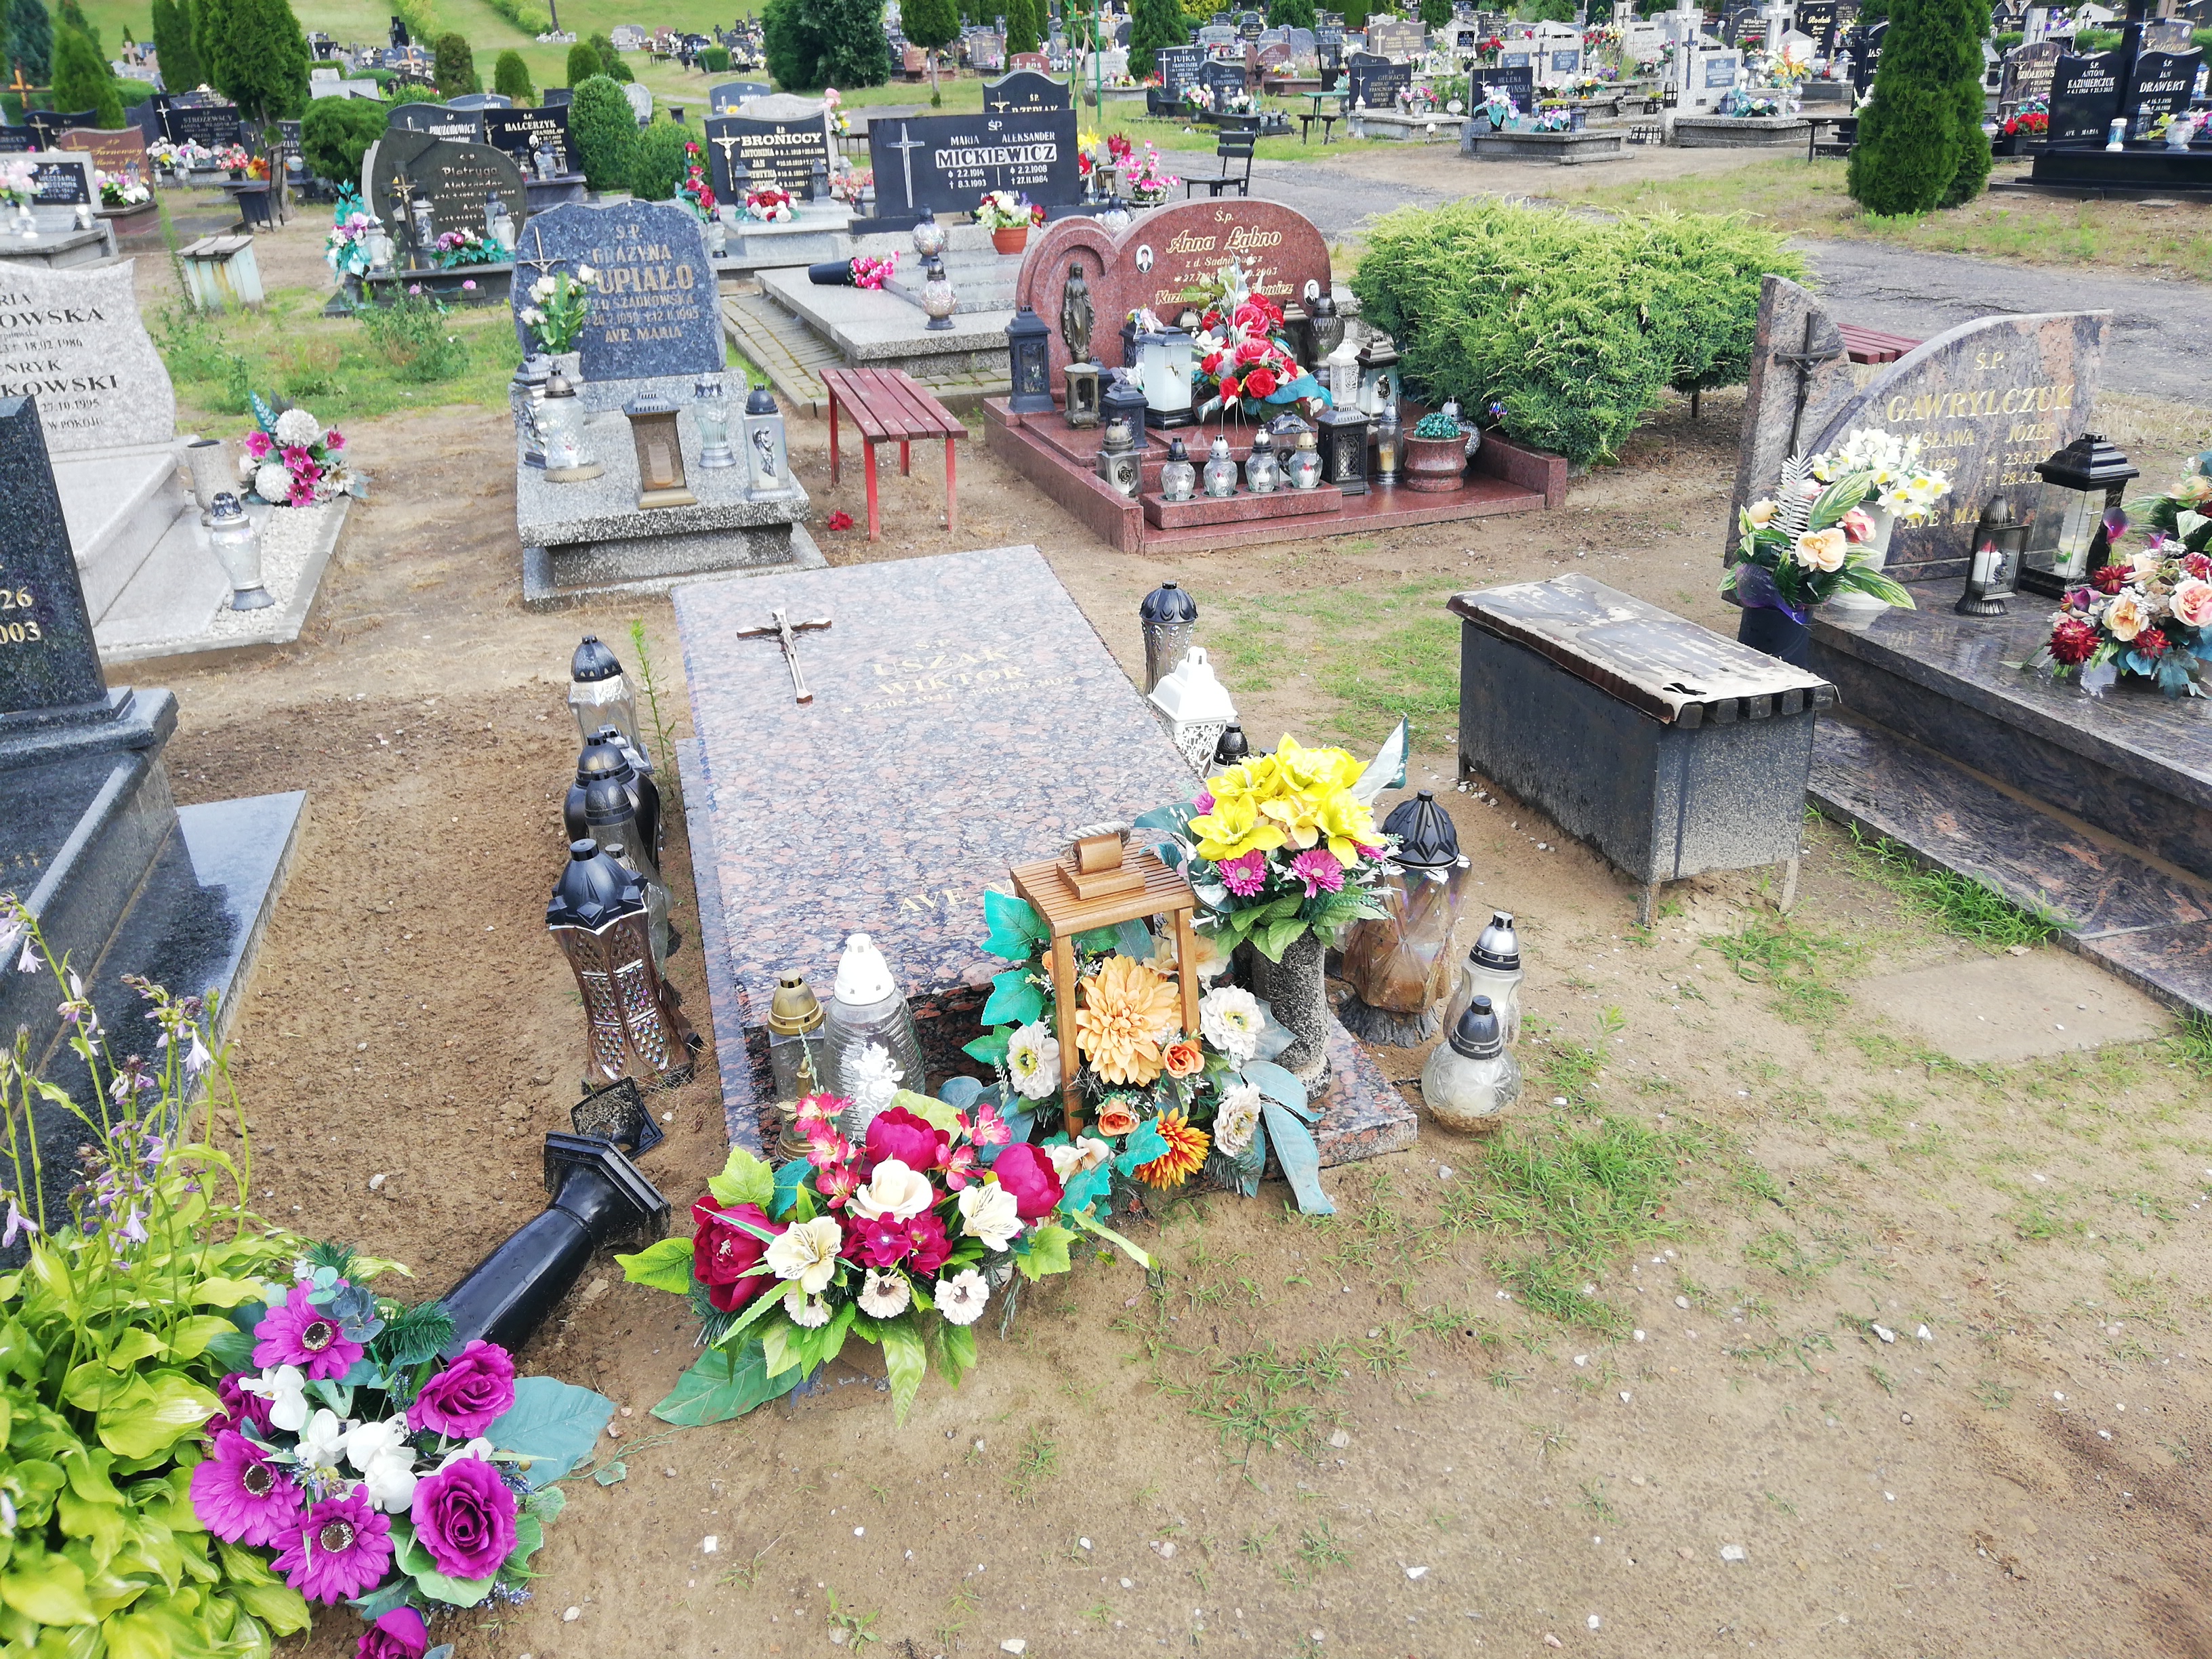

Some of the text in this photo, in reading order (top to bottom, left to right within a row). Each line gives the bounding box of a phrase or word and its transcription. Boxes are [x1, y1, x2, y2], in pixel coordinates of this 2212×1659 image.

[2081, 69, 2105, 77] ANTONI
[2067, 77, 2115, 89] KAZIMIERCZUK
[2139, 80, 2186, 93] DRAWERT
[504, 119, 556, 132] BALCERZYK
[741, 132, 822, 146] BRONICCY
[951, 131, 1056, 146] MARIA ALEKSANDER
[740, 148, 775, 158] ANTONINA
[936, 143, 1057, 169] MICKIEWICZ
[442, 166, 497, 178] Pietryga
[752, 159, 765, 168] JAN
[957, 165, 1048, 178] 2.2.1914 2.2.1908
[958, 178, 987, 189] 8.3.1993
[1214, 206, 1234, 224] Ś.p.
[1166, 229, 1219, 254] Anna
[588, 264, 694, 294] UPIAŁO
[605, 325, 683, 343] AVE MARIA
[1973, 348, 2005, 371] Ś.P.
[1, 375, 119, 398] KOWSKI
[1886, 384, 2075, 424] GAWRYLCZUK
[60, 415, 104, 430] POKOJU
[2005, 420, 2057, 444] JÓZEF
[873, 649, 1011, 676] USZAK
[878, 665, 1027, 695] WIKTOR
[861, 692, 953, 712] 24.05.1941
[899, 887, 969, 915] AVE
